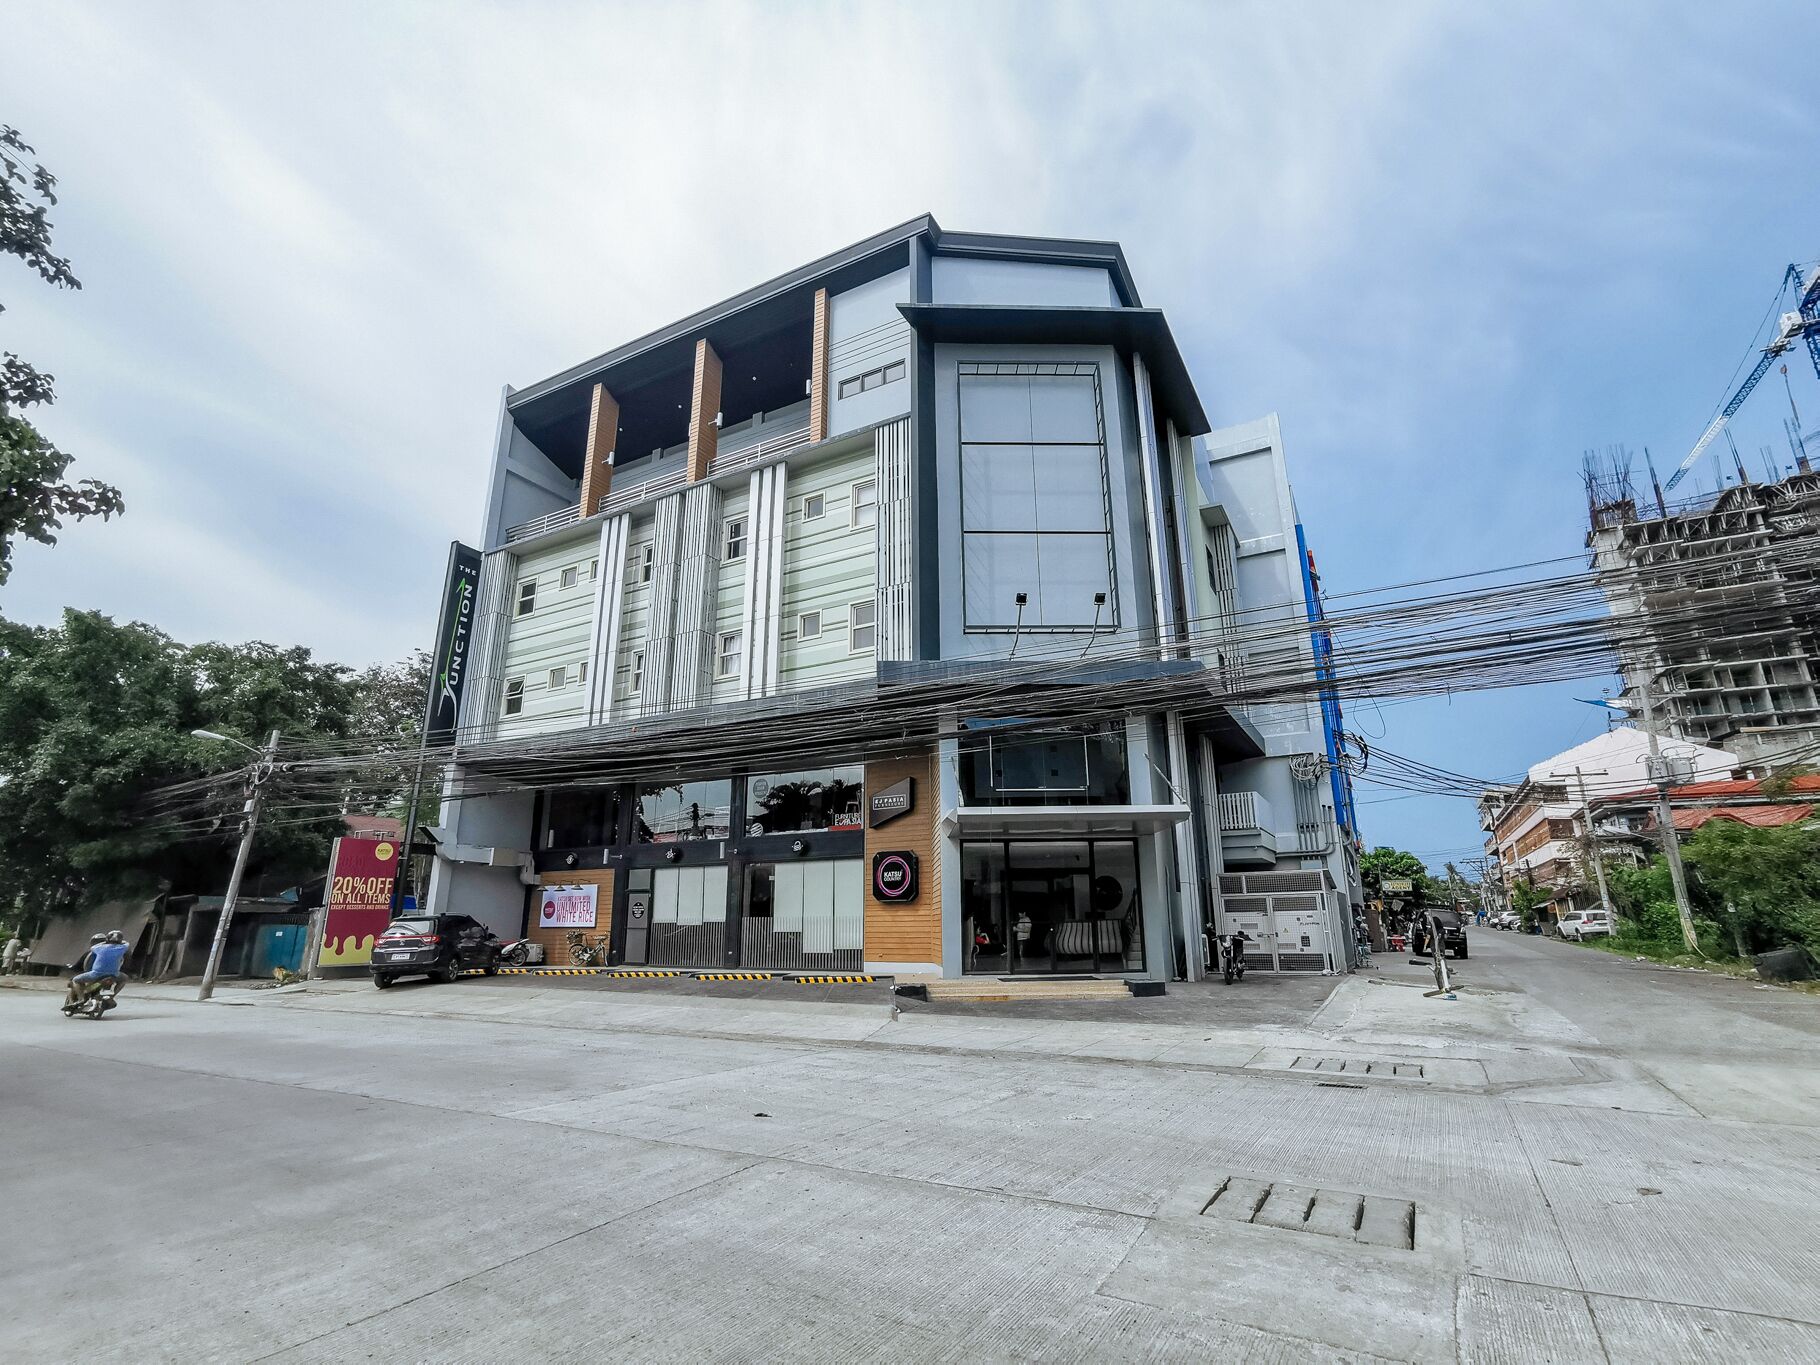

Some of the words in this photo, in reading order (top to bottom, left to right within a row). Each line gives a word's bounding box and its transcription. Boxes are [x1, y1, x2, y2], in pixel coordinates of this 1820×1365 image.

[459, 564, 477, 576] THE
[331, 893, 344, 904] ON
[345, 893, 362, 904] ALL
[364, 893, 391, 904] ITEMS
[556, 900, 591, 912] UNLIMITED
[556, 911, 577, 922] WHITE
[578, 911, 593, 922] RICE
